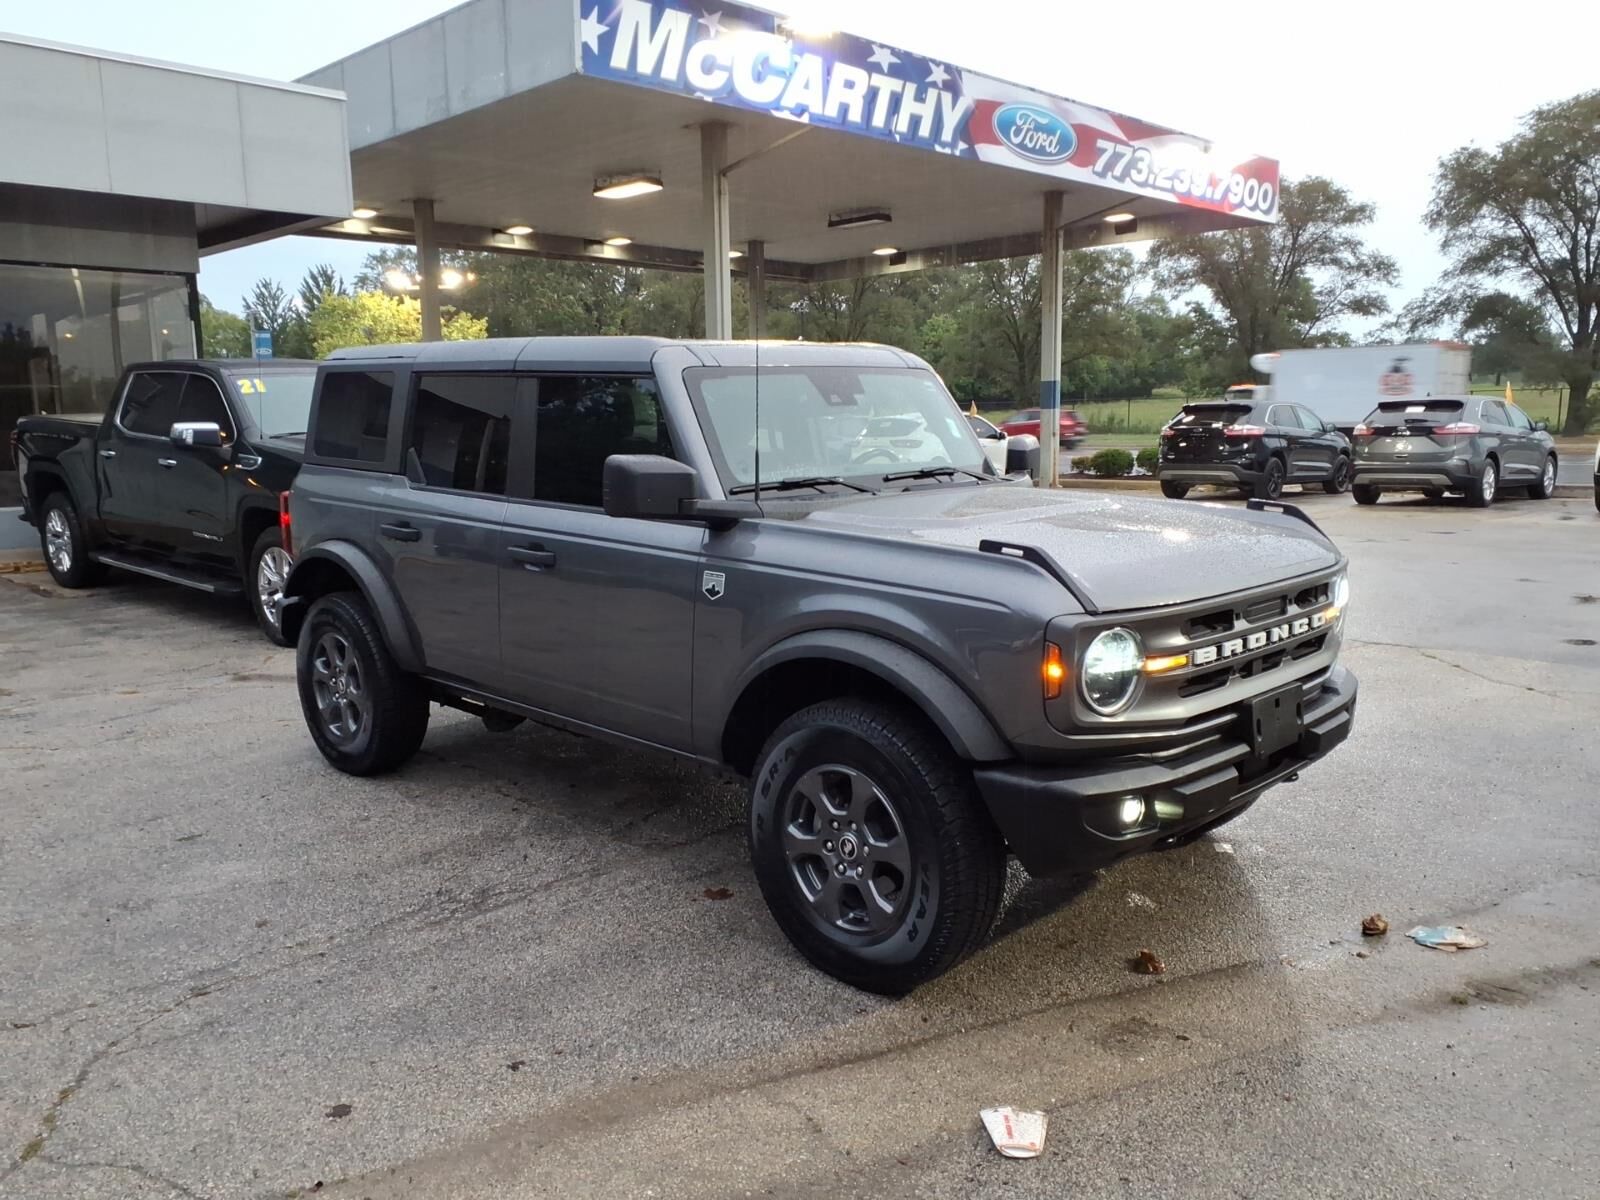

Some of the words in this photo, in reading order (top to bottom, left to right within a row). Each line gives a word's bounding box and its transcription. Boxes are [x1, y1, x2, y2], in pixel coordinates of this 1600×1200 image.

[1009, 110, 1062, 156] Ford
[236, 379, 267, 394] 21
[1193, 612, 1326, 665] BRONCO
